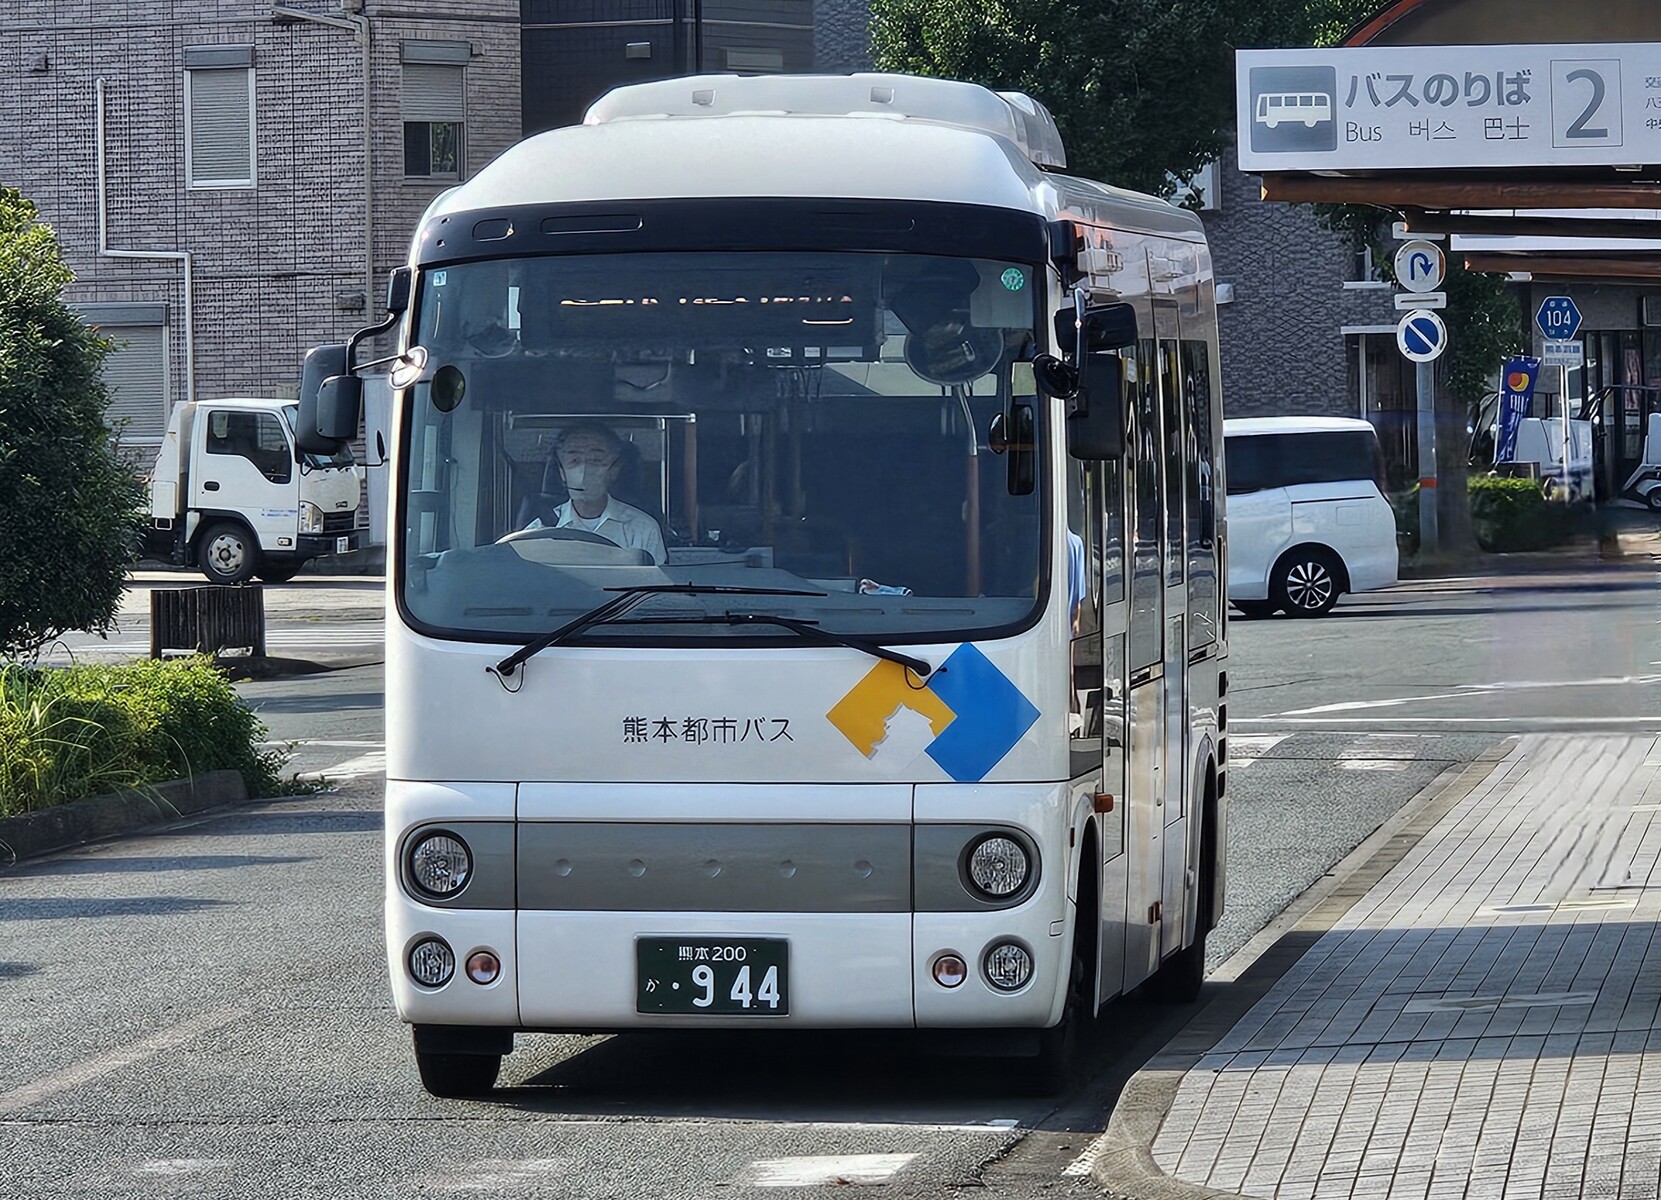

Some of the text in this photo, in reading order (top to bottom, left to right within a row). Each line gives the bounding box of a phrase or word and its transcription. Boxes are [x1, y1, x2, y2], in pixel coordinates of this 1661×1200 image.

[1345, 69, 1532, 108] バスのりば
[1565, 68, 1609, 139] 2
[1346, 121, 1383, 142] Bus
[1409, 118, 1457, 142] 버스
[1484, 116, 1530, 141] 巴士
[1546, 310, 1571, 327] 104
[622, 716, 795, 746] 熊本都市バス
[711, 946, 747, 961] 200
